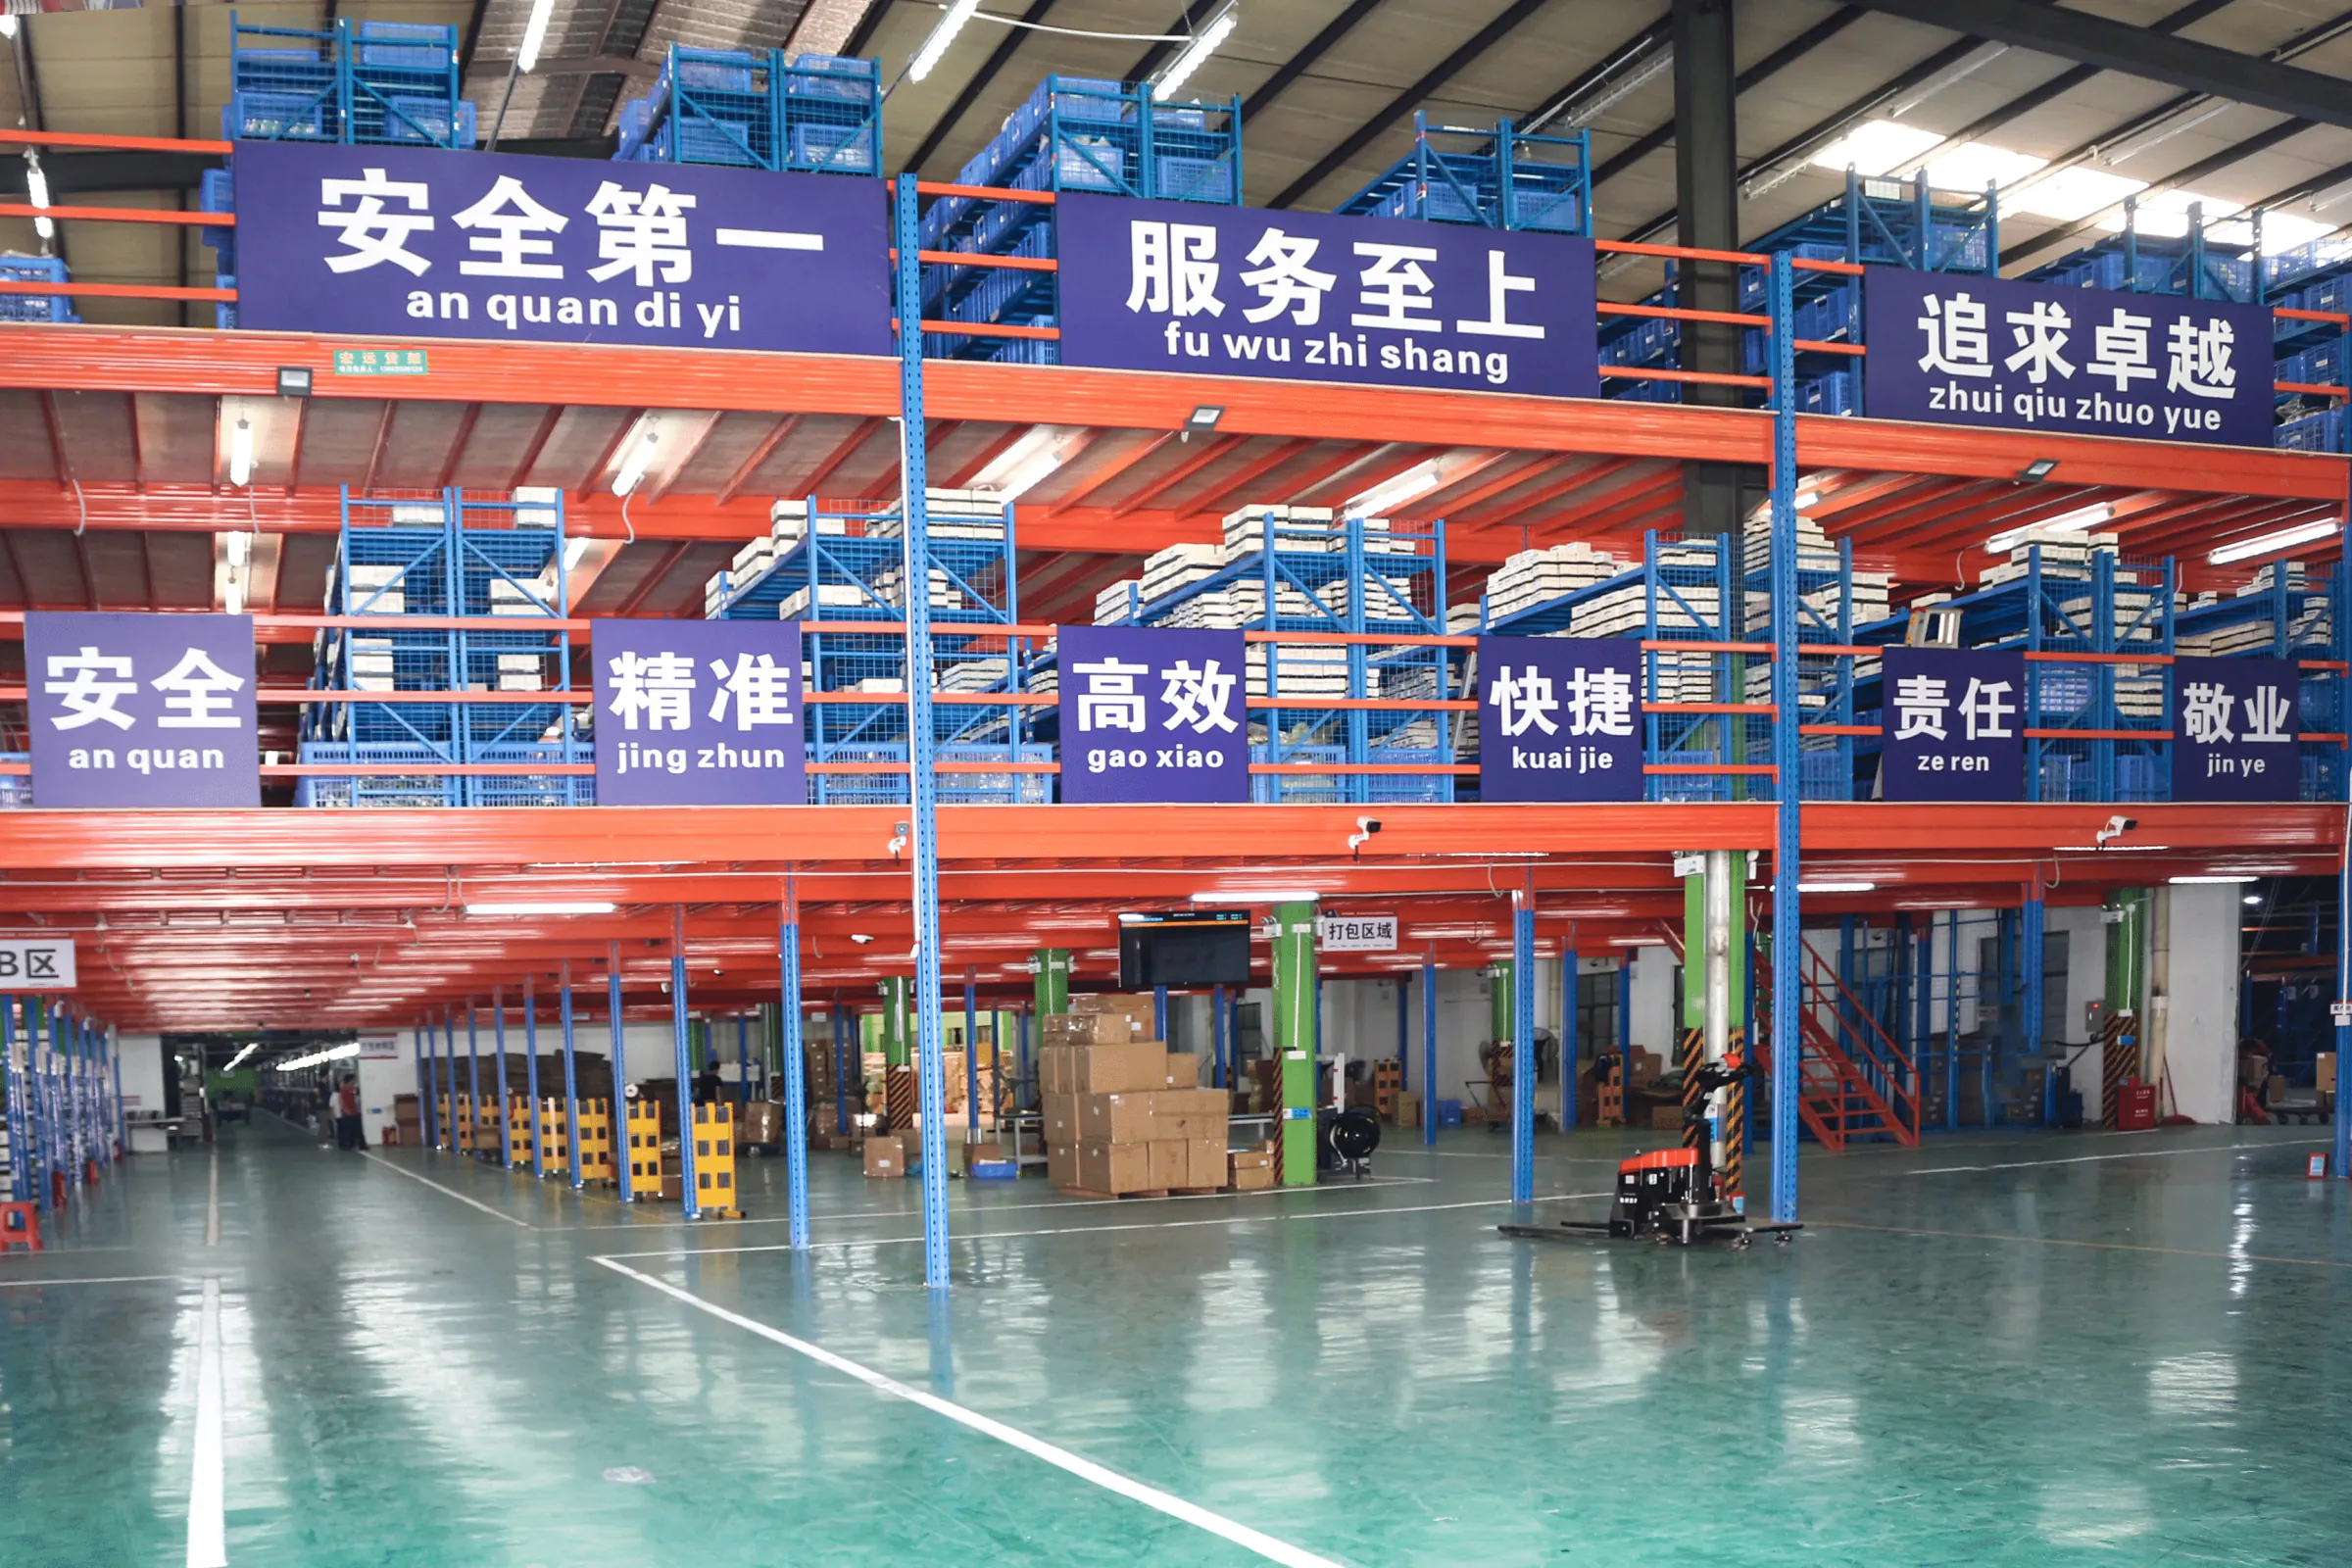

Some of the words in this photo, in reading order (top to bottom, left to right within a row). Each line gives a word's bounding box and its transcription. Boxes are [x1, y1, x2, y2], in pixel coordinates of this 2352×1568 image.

[318, 169, 823, 286] 安全第一
[1126, 220, 1544, 339] 服务至上
[406, 290, 468, 319] an
[486, 293, 617, 329] quan
[634, 291, 681, 327] di
[696, 295, 740, 338] yi
[1164, 320, 1209, 357] fu
[1222, 333, 1291, 363] wu
[1304, 331, 1367, 367] zhi
[1380, 337, 1508, 384] shang
[1917, 292, 2236, 399] 追求卓越
[1929, 380, 2003, 414] zhui
[2013, 387, 2066, 422] qiu
[2076, 392, 2154, 425] zhuo
[2164, 406, 2221, 434] yue
[44, 646, 246, 731] 安全
[608, 650, 794, 731] 精准
[1072, 657, 1240, 734] 高效
[1489, 665, 1635, 737] 快捷
[1892, 674, 2017, 741] 责任
[2182, 682, 2291, 744] 敬业
[69, 748, 116, 769] an
[126, 748, 224, 775] quan
[615, 741, 687, 775] jing
[697, 742, 785, 768] zhun
[1087, 749, 1148, 773] gao
[1155, 743, 1224, 768] xiao
[1512, 746, 1572, 769] kuai
[1579, 746, 1613, 774] jie
[1918, 755, 1944, 771] ze
[1951, 755, 1989, 771] ren
[2207, 754, 2234, 777] jin
[2240, 759, 2266, 777] ye
[1329, 922, 1393, 941] 打包区域
